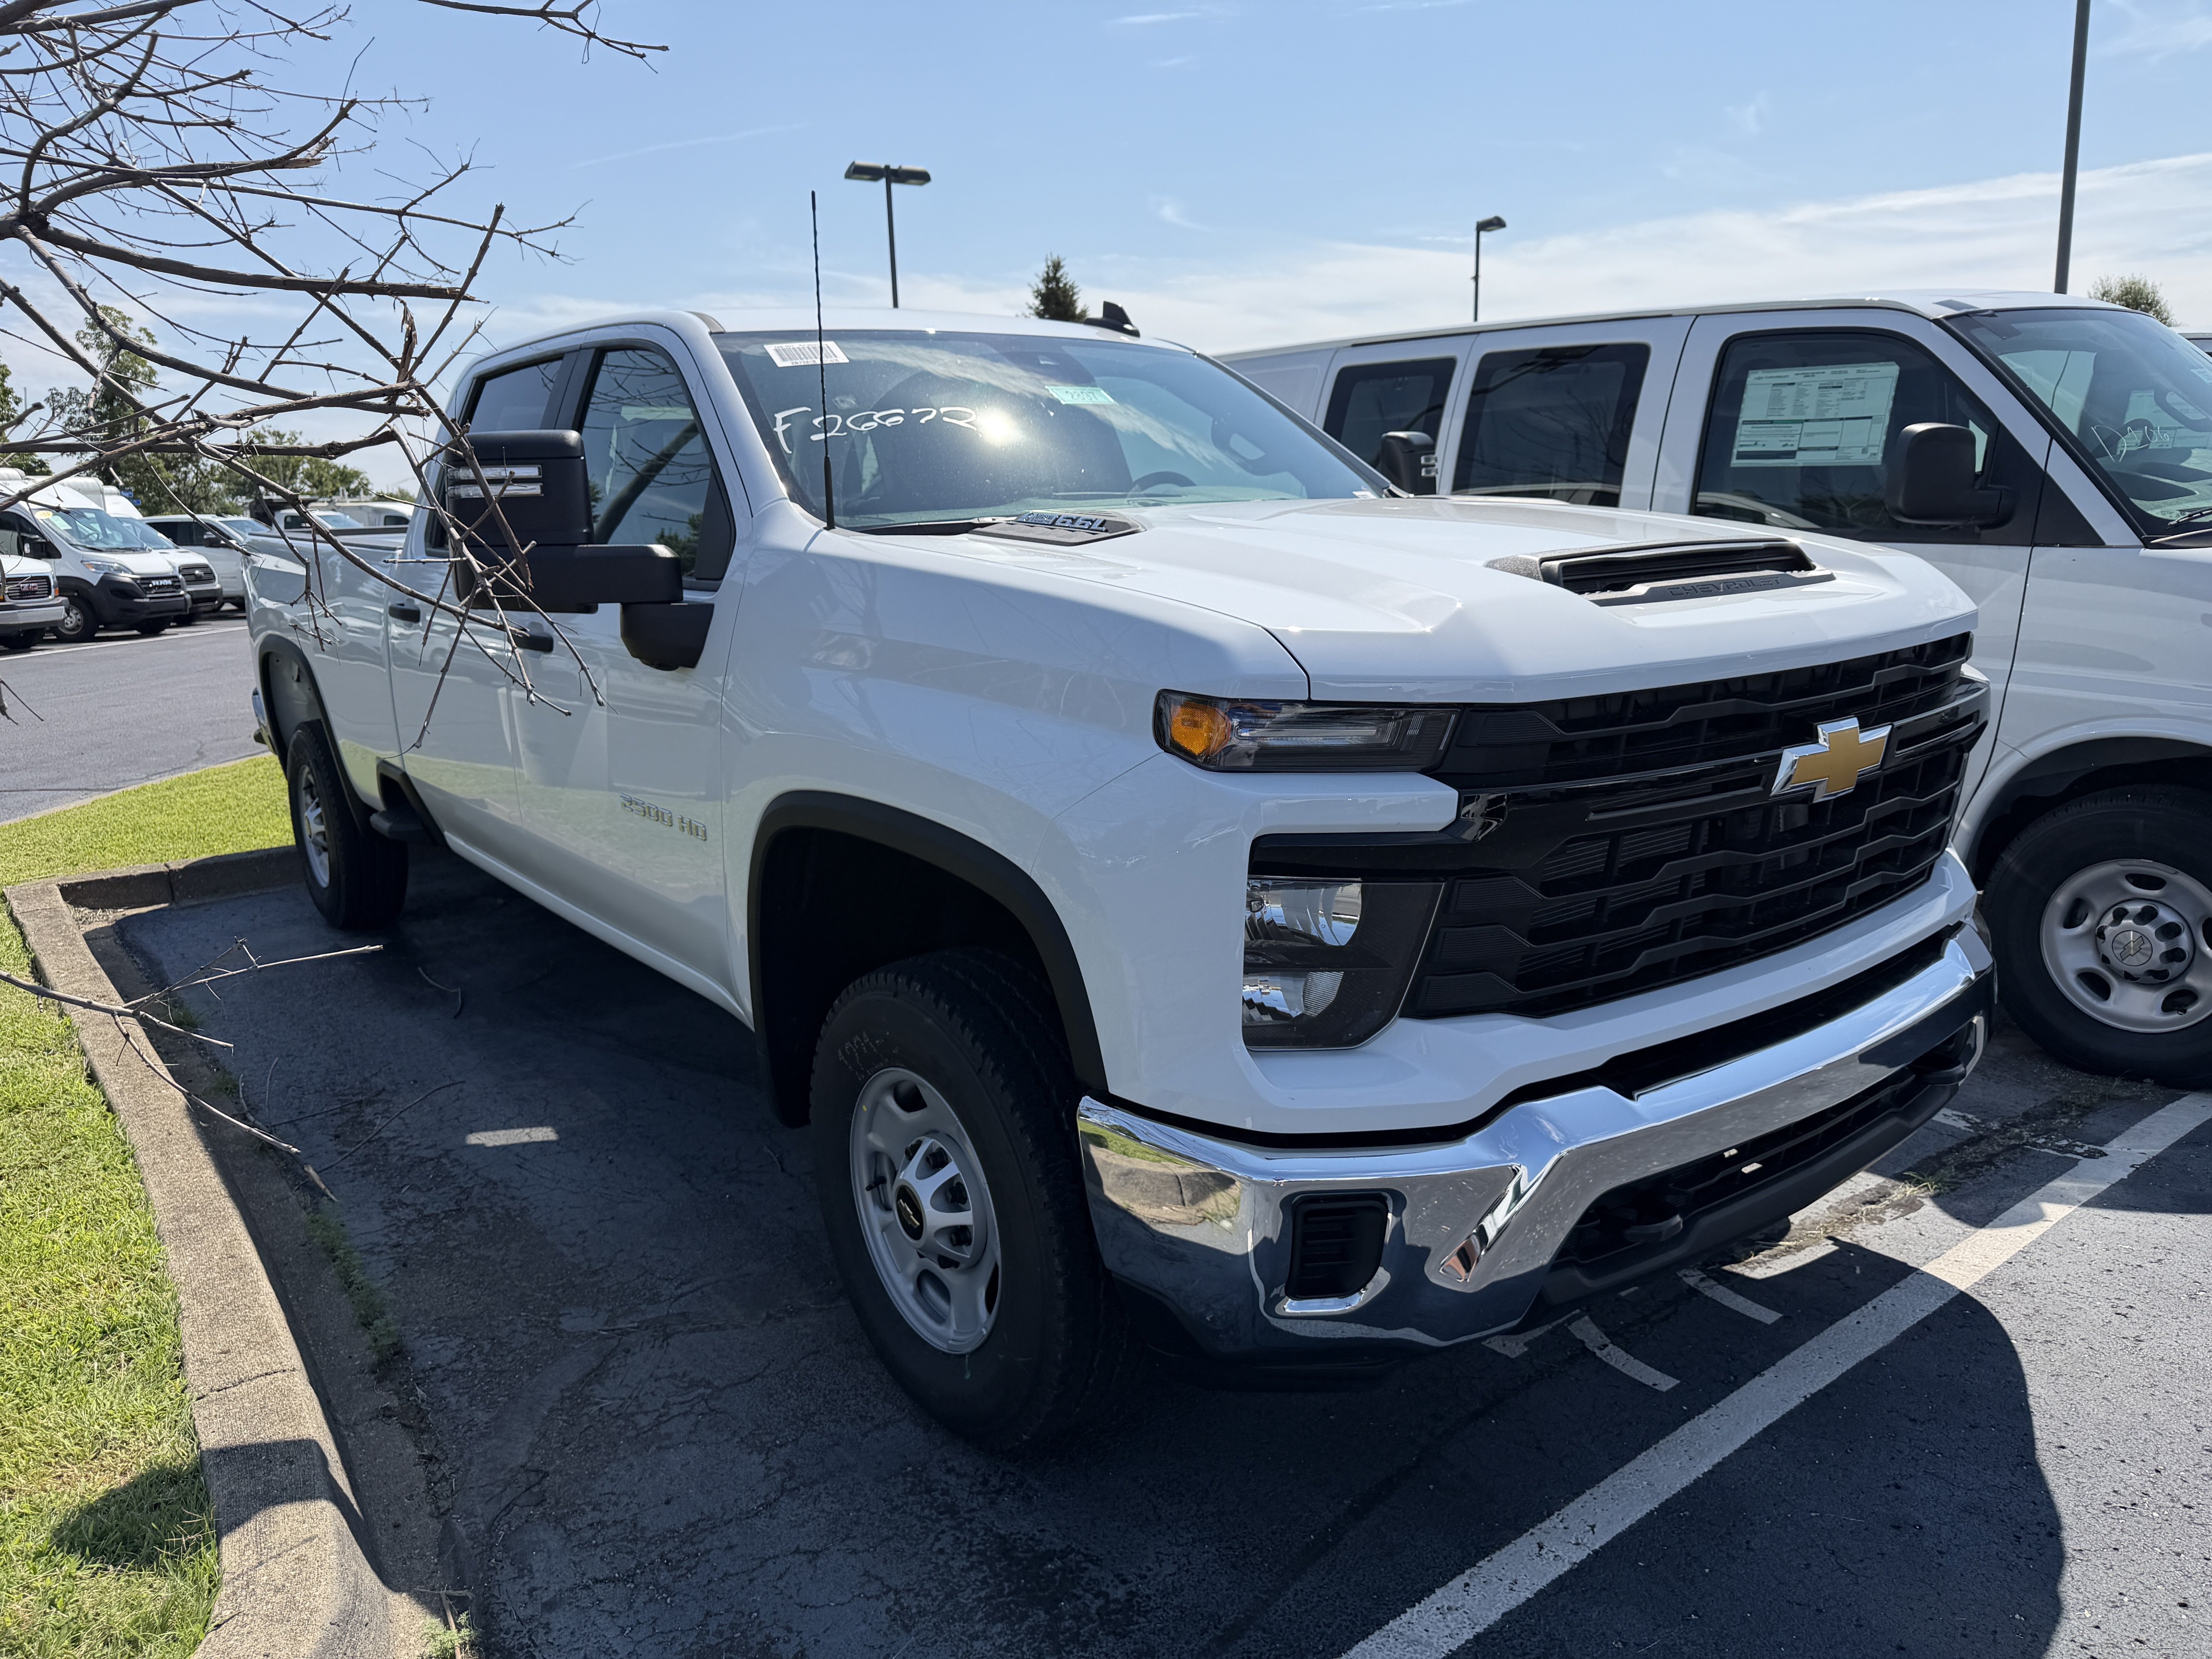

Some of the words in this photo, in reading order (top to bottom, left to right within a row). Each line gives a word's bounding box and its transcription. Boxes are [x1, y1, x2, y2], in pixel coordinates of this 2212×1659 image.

[1055, 514, 1107, 532] 6.6L
[1667, 577, 1780, 596] CHEVROLET
[620, 792, 673, 826] 2500
[678, 814, 707, 841] HD
